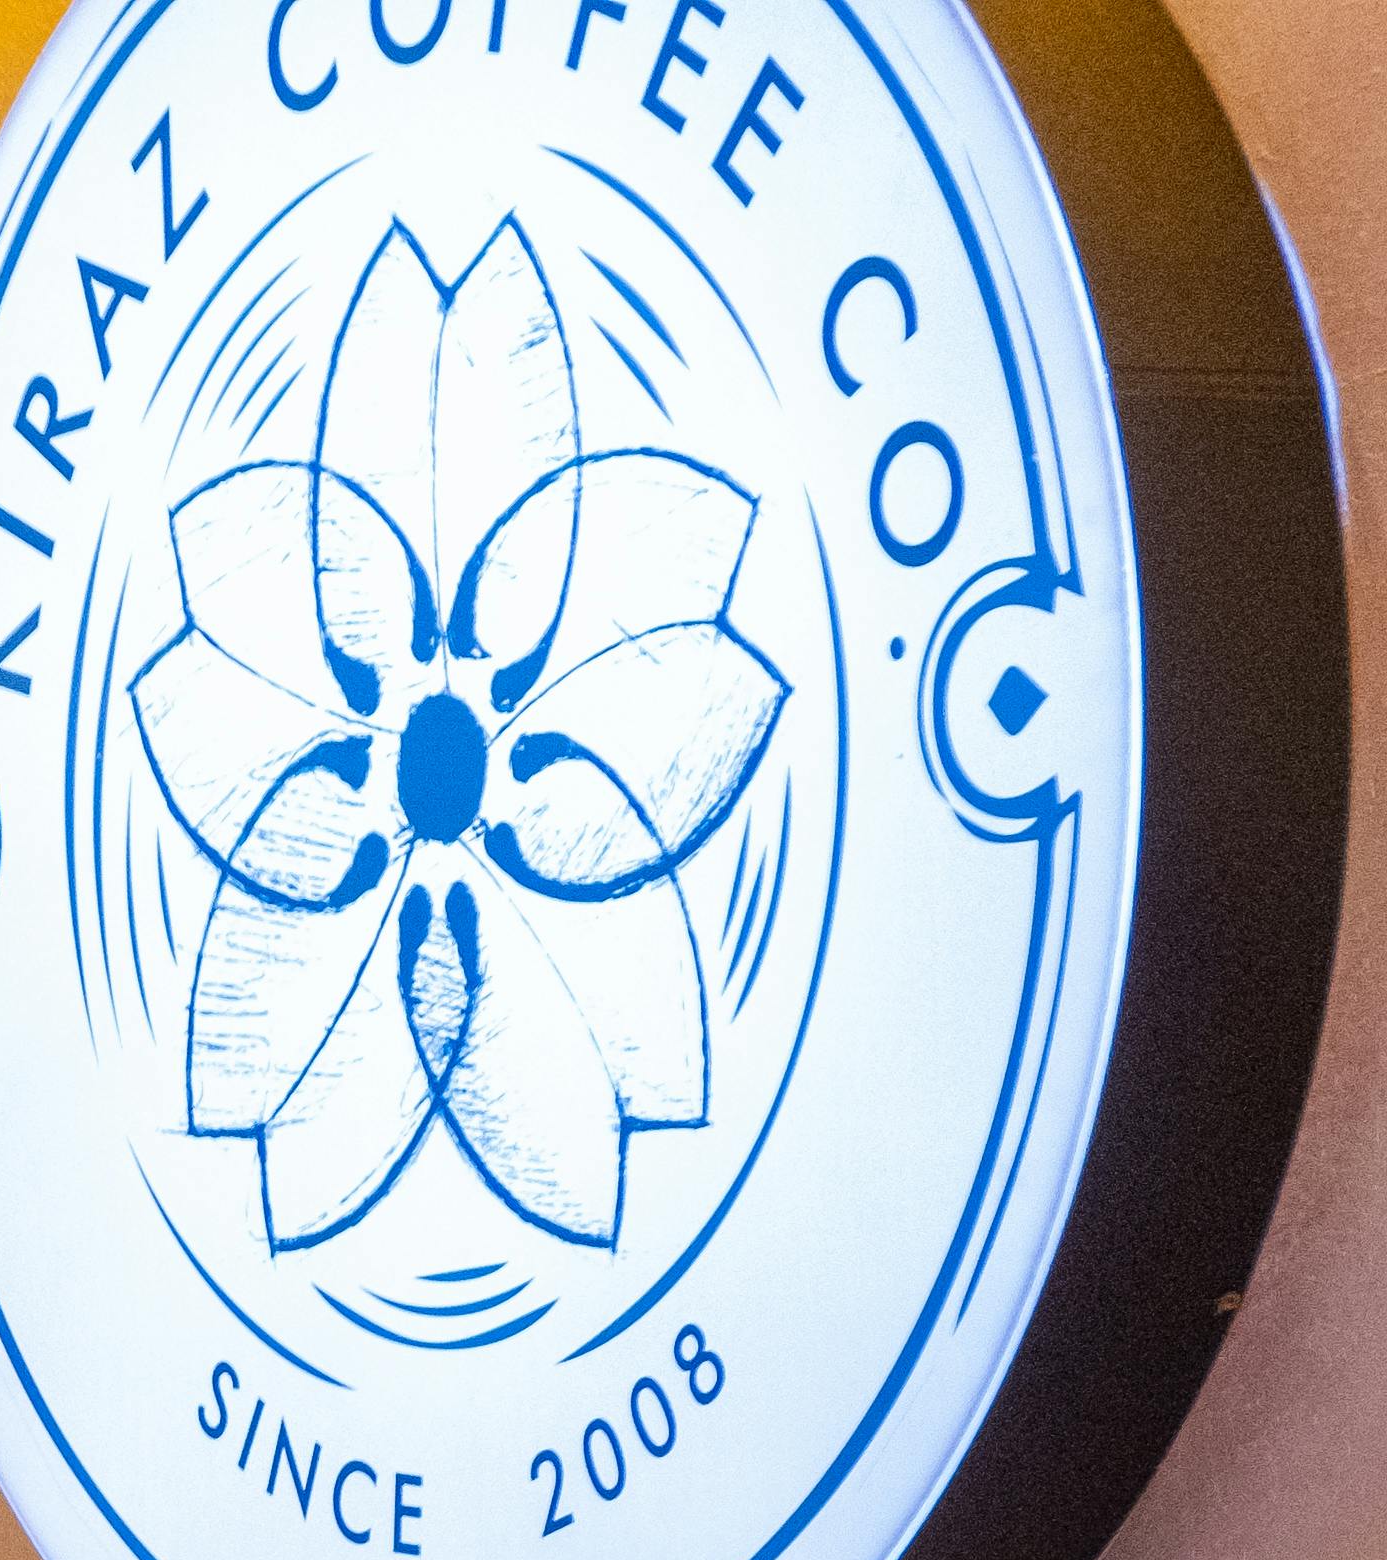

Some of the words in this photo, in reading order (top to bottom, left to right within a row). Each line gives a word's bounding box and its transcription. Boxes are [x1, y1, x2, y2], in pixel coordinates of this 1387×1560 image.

[821, 254, 966, 662] CO.
[197, 1360, 424, 1557] SINCE
[529, 1322, 726, 1538] 2008
